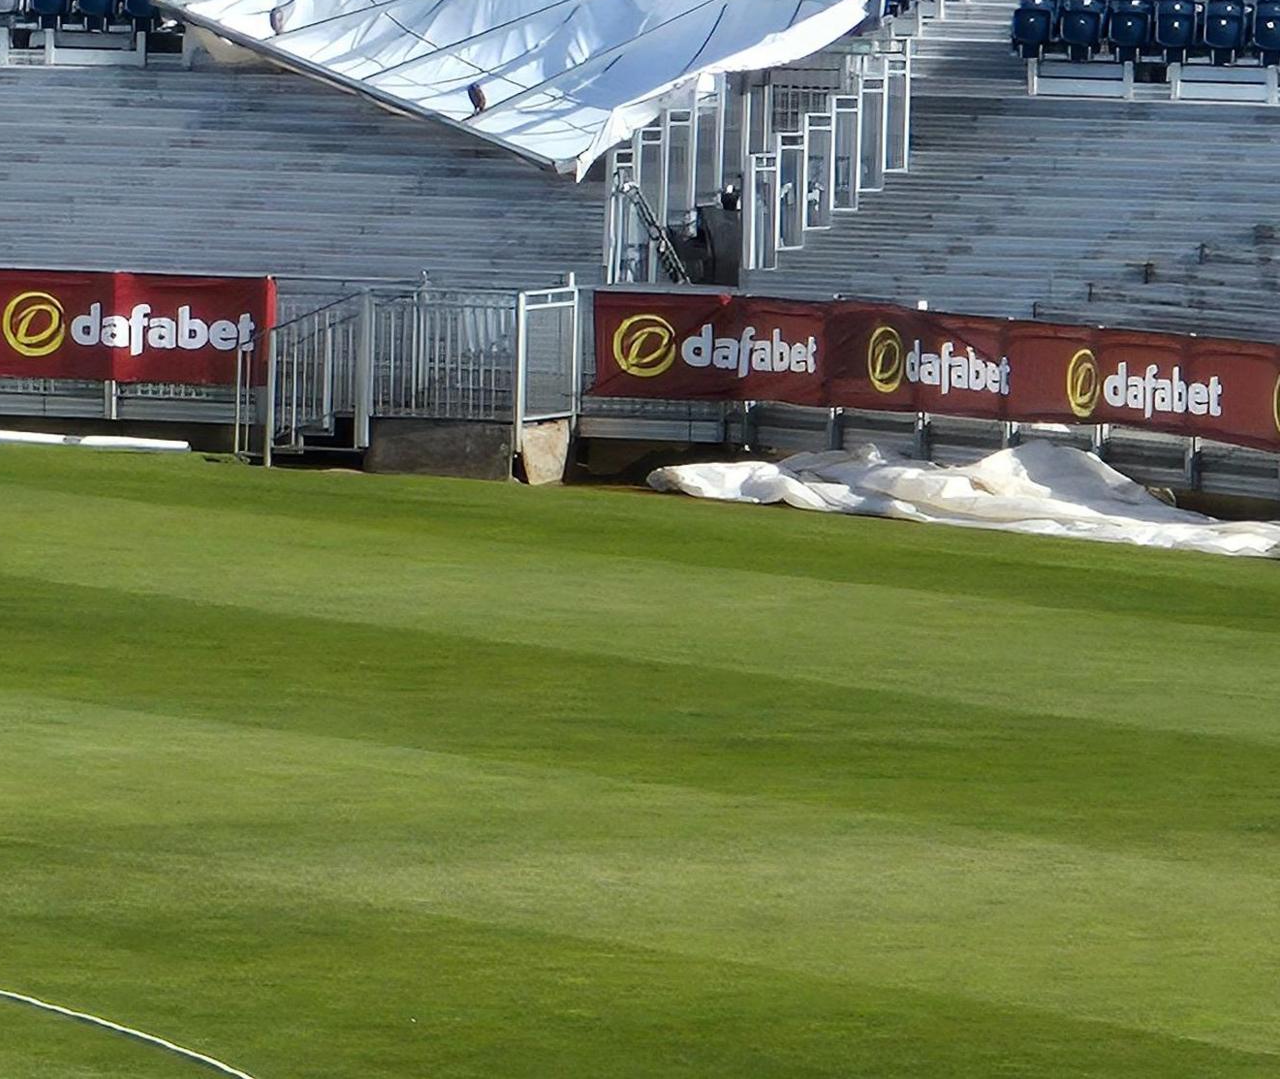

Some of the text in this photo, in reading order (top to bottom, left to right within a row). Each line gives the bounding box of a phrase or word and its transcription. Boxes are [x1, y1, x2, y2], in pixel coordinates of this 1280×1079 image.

[71, 303, 254, 355] dafabet
[682, 324, 816, 377] dafabet
[906, 340, 1010, 394] dafabet
[1103, 362, 1222, 418] dafabet
